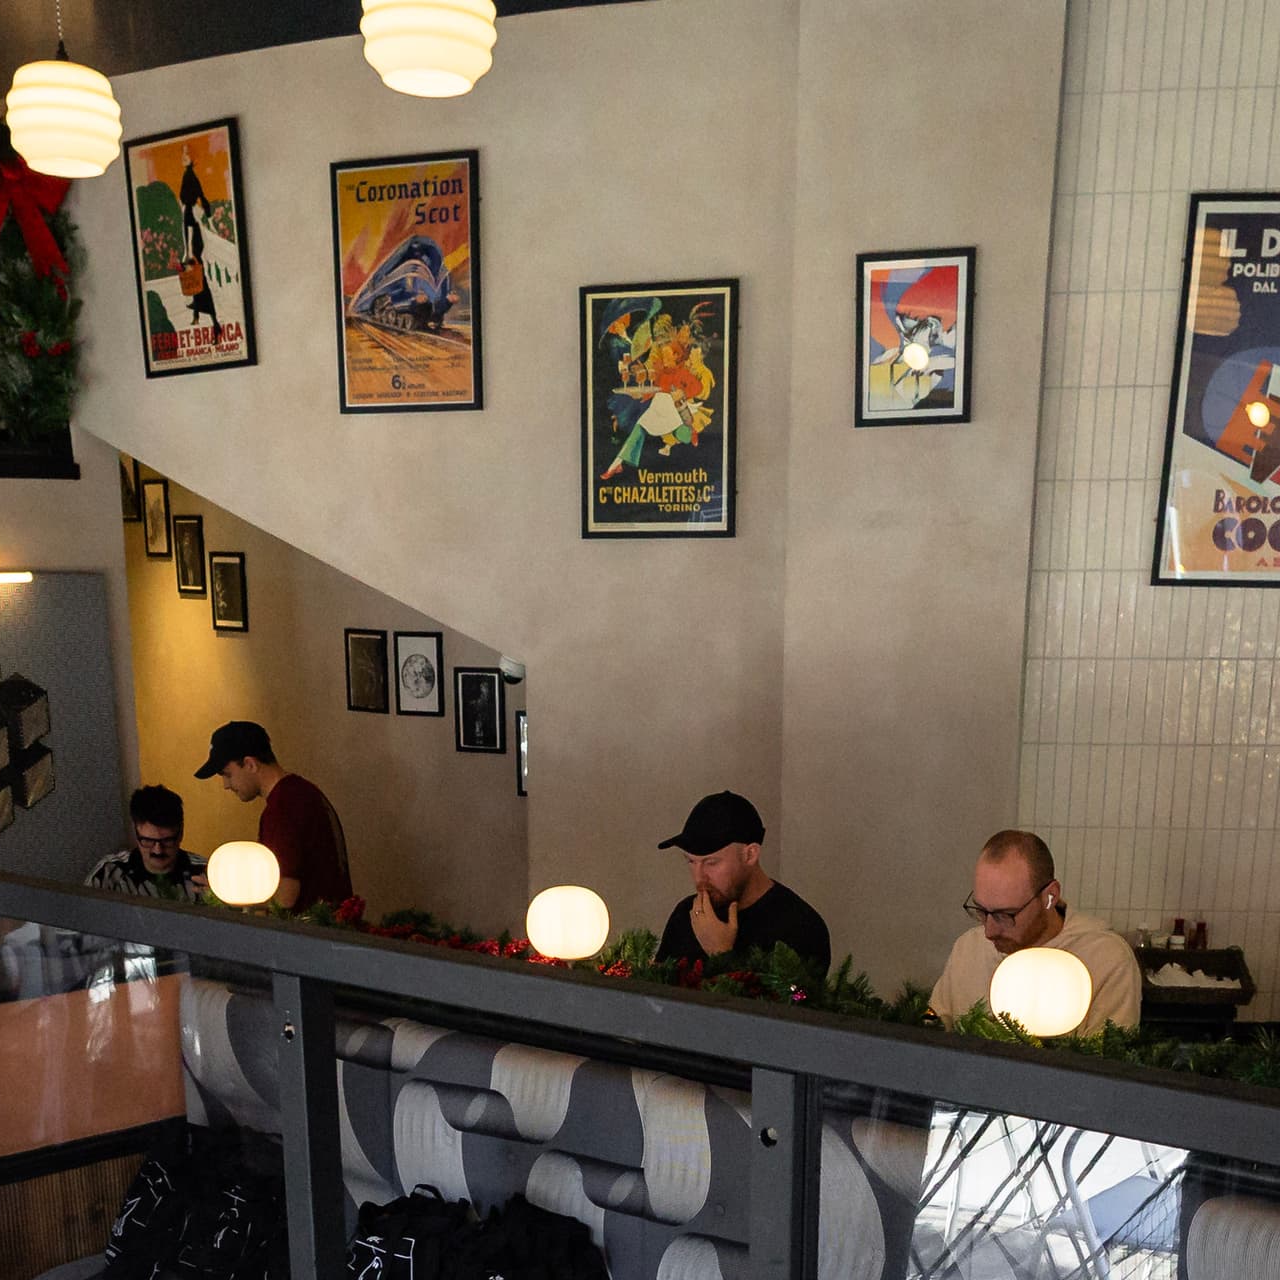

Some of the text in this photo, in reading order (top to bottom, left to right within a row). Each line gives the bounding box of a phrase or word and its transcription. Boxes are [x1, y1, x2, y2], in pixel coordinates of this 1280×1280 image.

[356, 176, 464, 203] Coronation
[415, 203, 461, 224] Scot
[1219, 228, 1248, 258] IL
[1252, 281, 1278, 293] DAL
[638, 467, 708, 484] Vermouth
[614, 486, 696, 504] CHAZALETTES
[658, 503, 700, 512] TORINO
